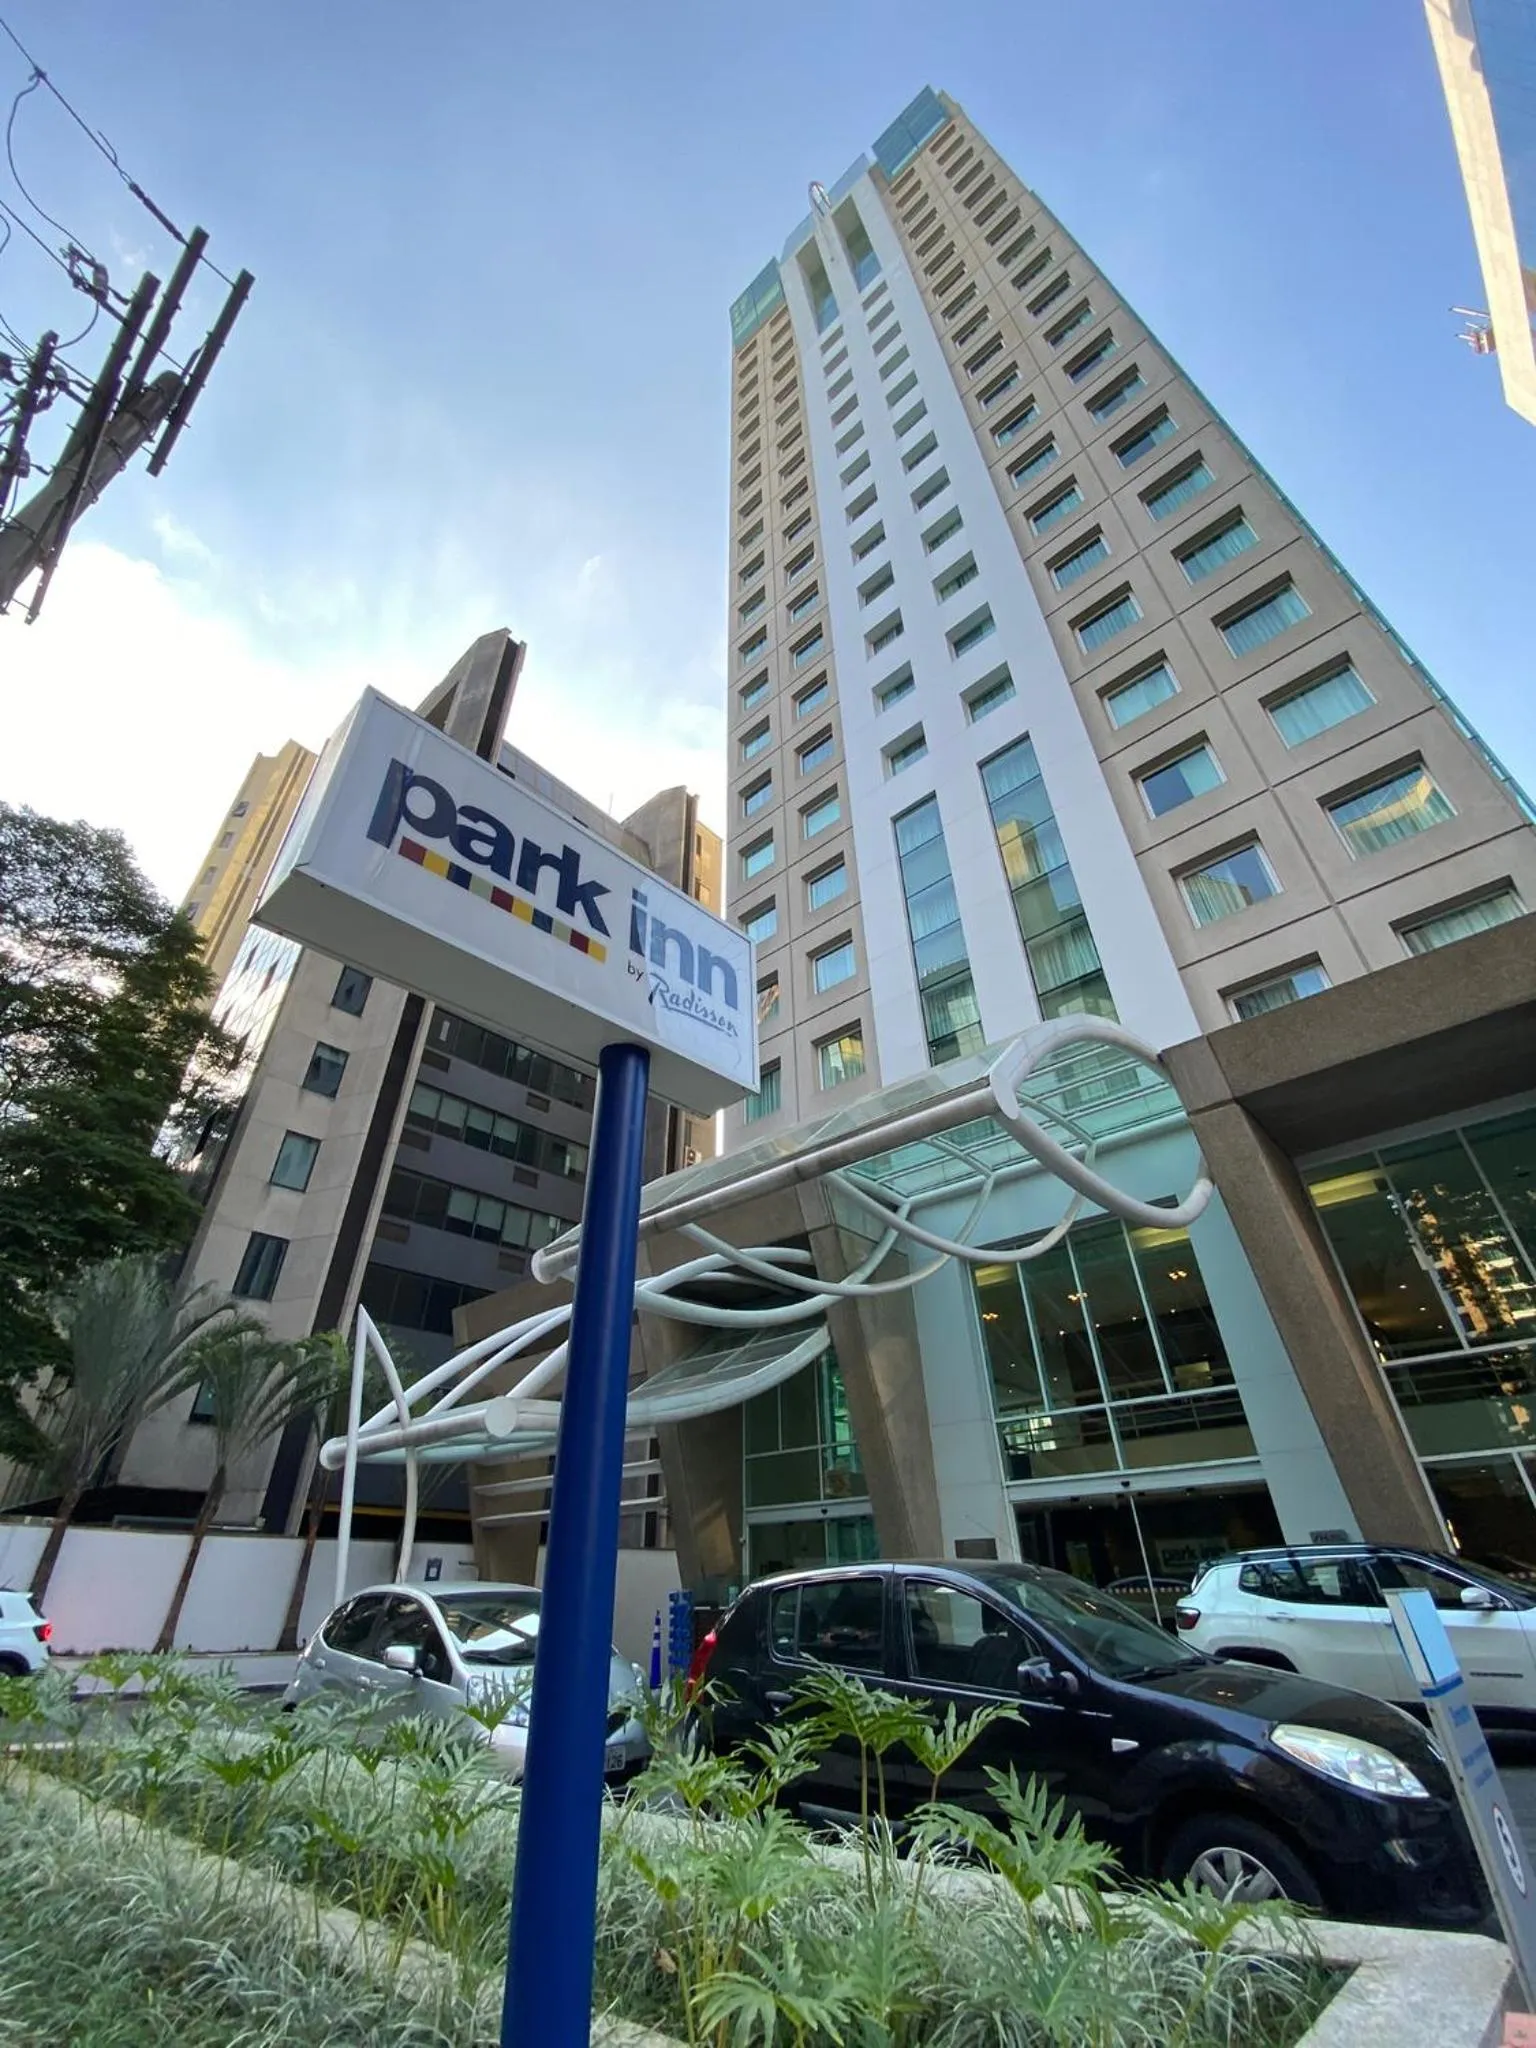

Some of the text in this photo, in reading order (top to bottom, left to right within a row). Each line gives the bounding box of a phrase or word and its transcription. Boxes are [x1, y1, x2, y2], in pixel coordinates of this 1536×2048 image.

[366, 757, 738, 1010] park inn
[627, 960, 738, 1037] by Radisson
